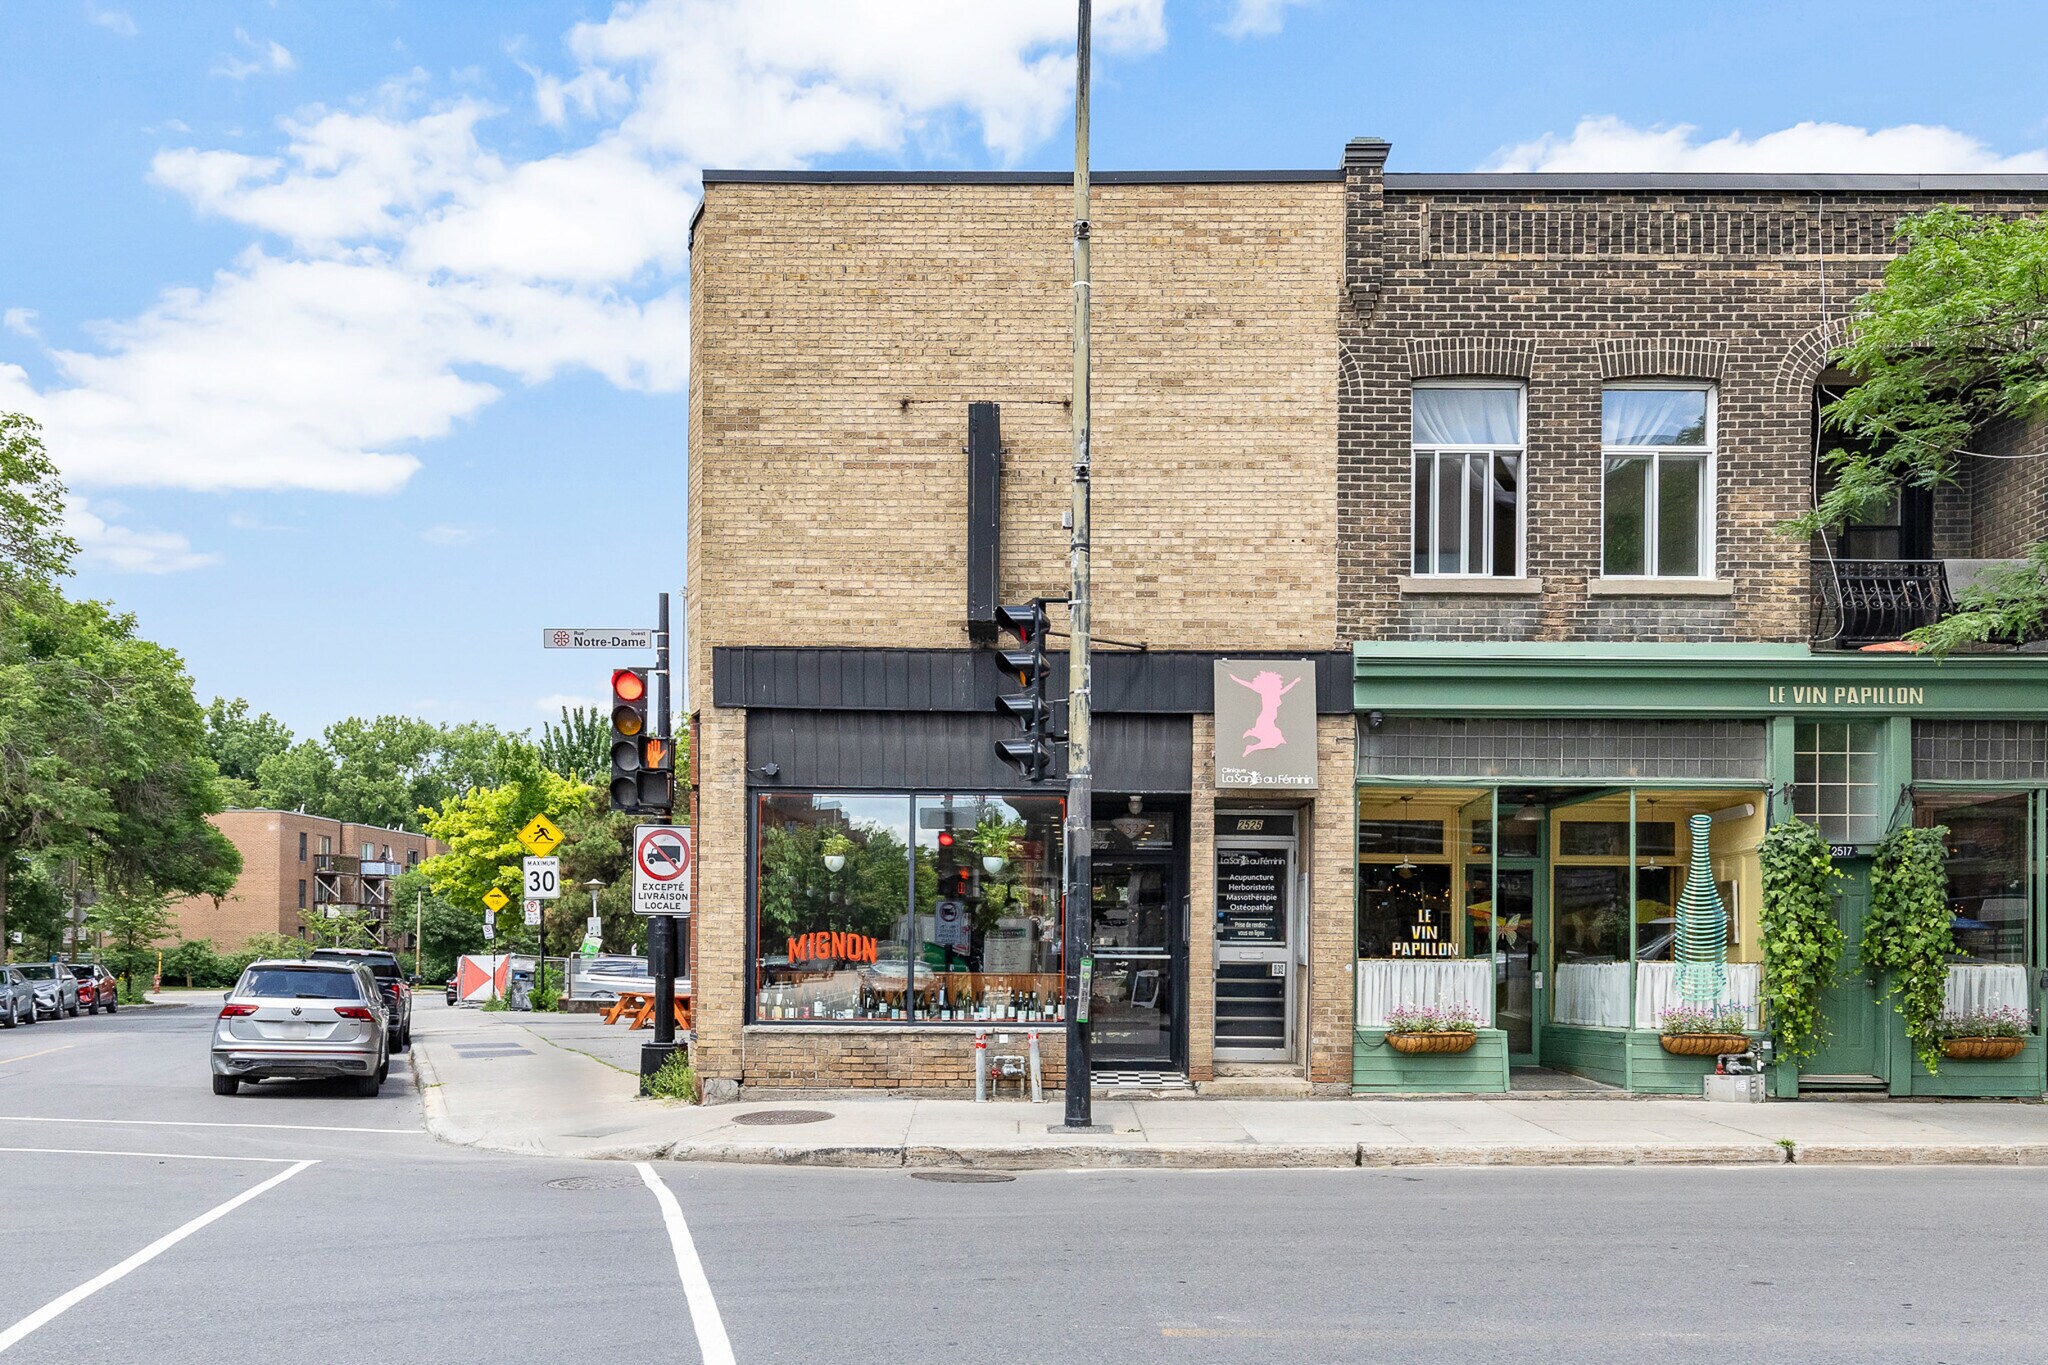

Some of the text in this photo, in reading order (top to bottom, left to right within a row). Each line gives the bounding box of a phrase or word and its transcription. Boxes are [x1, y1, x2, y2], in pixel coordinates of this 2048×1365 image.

[574, 637, 646, 647] Notre-Dame
[1769, 686, 1923, 705] LE VIN PAPILLON
[1222, 767, 1247, 775] Clinique
[1222, 774, 1234, 783] La
[1264, 776, 1277, 784] au
[1278, 774, 1314, 784] Féminin
[1238, 820, 1263, 830] 2525
[1831, 846, 1853, 856] 2517
[1260, 857, 1286, 865] Féminin
[529, 871, 555, 892] 30
[1230, 874, 1274, 882] Acupuncture
[642, 881, 685, 891] EXCEPTÉ
[638, 892, 688, 900] LIVRAISON
[1226, 894, 1277, 902] Massothérapie
[645, 902, 681, 910] LOCALE
[1229, 904, 1274, 912] Ostéopathie
[1418, 909, 1432, 923] LE
[1411, 925, 1438, 939] VIN
[788, 931, 878, 965] MIGNON
[1392, 942, 1459, 956] PAPILLON
